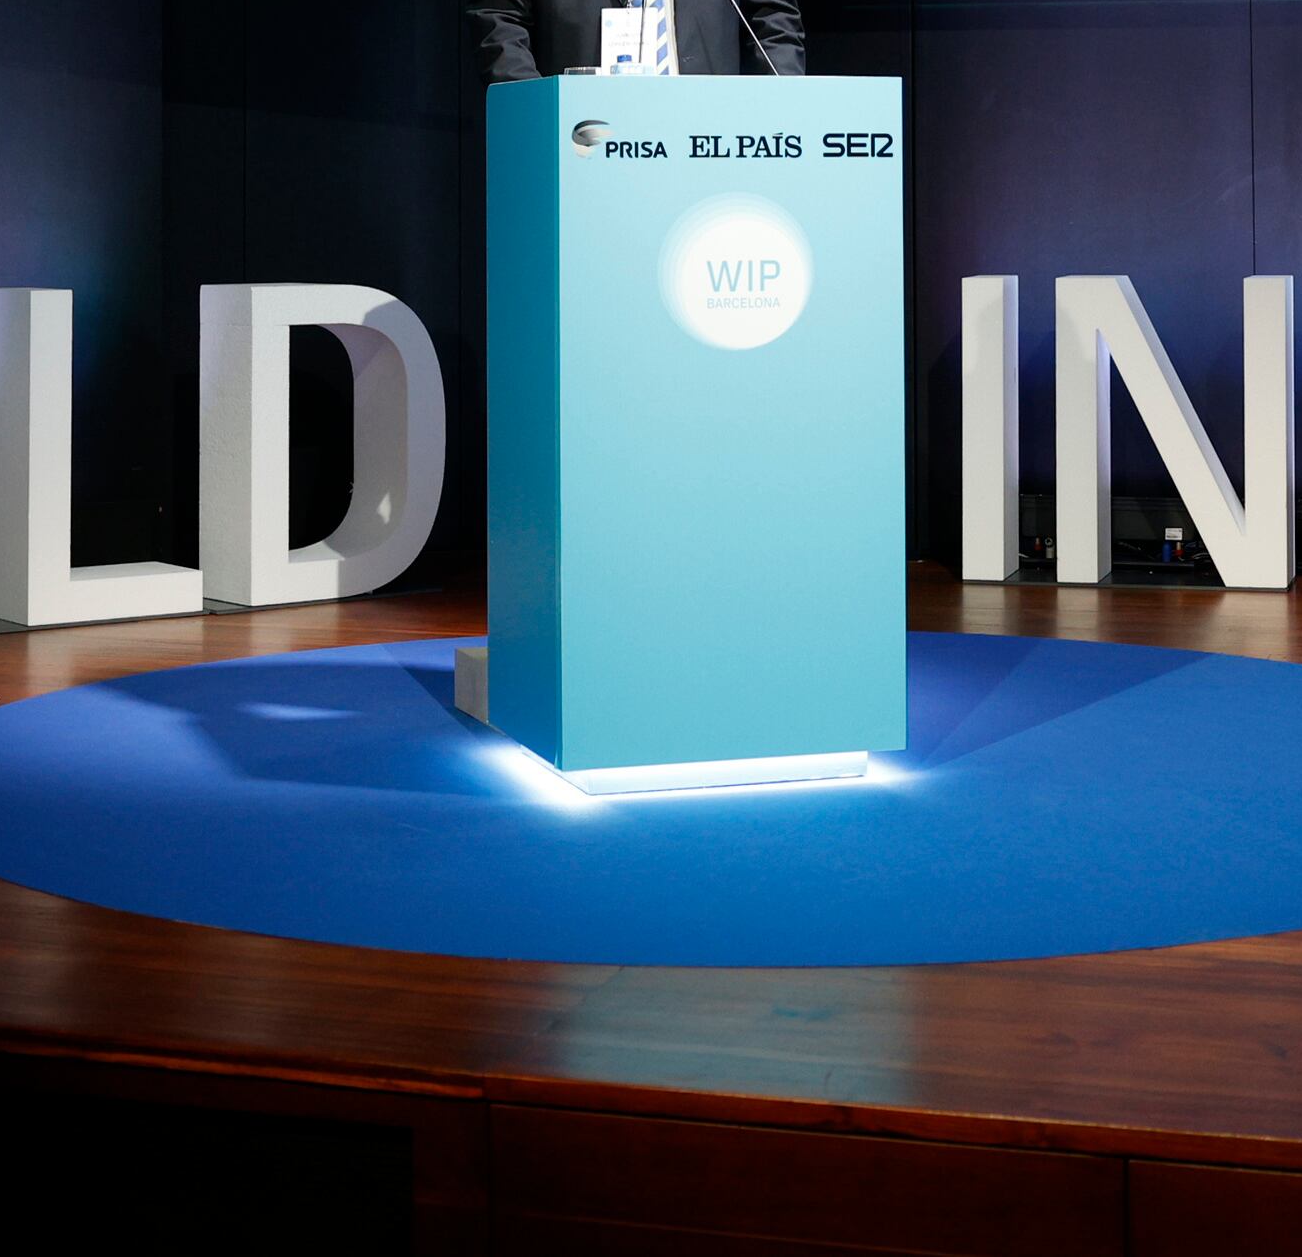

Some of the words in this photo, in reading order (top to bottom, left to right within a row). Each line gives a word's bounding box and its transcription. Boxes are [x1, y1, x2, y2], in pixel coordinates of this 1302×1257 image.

[605, 141, 668, 158] PRISA
[689, 135, 730, 158] EL
[736, 132, 803, 158] PAÍS
[822, 133, 895, 158] SER
[706, 260, 781, 292] WIP
[706, 297, 781, 309] BARCELONA
[961, 274, 1295, 589] IN
